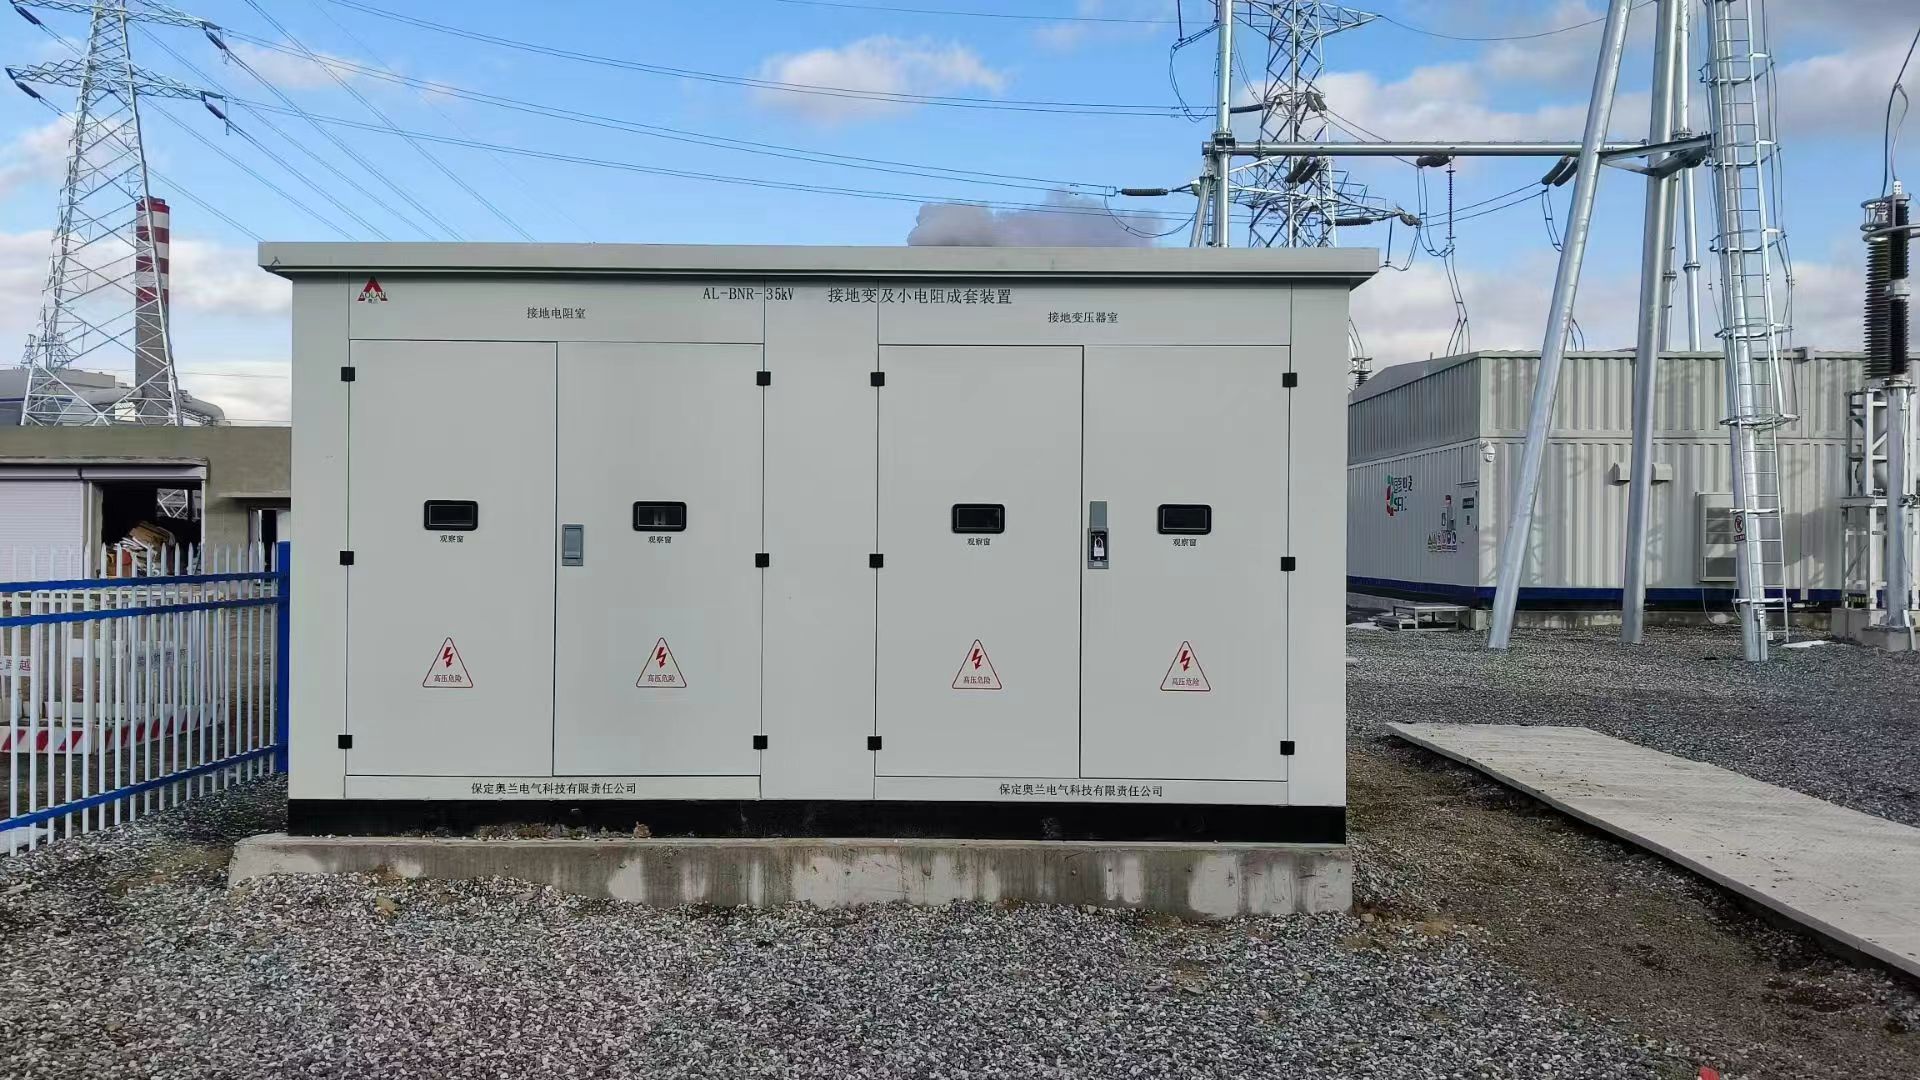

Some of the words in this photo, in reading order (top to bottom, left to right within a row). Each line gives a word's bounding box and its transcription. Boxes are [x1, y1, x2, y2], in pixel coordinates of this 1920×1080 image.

[703, 286, 795, 301] AL-BNR-35kV
[827, 286, 1013, 305] 接地变及小电阻成套装置
[526, 306, 586, 320] 接地电阻室
[1047, 311, 1119, 324] 接地变压器室
[439, 534, 465, 544] 观察窗
[647, 535, 672, 545] 观察窗
[967, 537, 991, 547] 观察窗
[1172, 537, 1198, 548] 观察窗
[433, 673, 463, 684] 高压危险
[647, 673, 676, 684] 高压危险
[963, 675, 991, 686] 高压危险
[1171, 677, 1200, 688] 高压危险
[471, 781, 637, 796] 保定奥兰电气科技有限责任公司
[998, 783, 1164, 798] 保定奥兰电气科技有限责任公司
